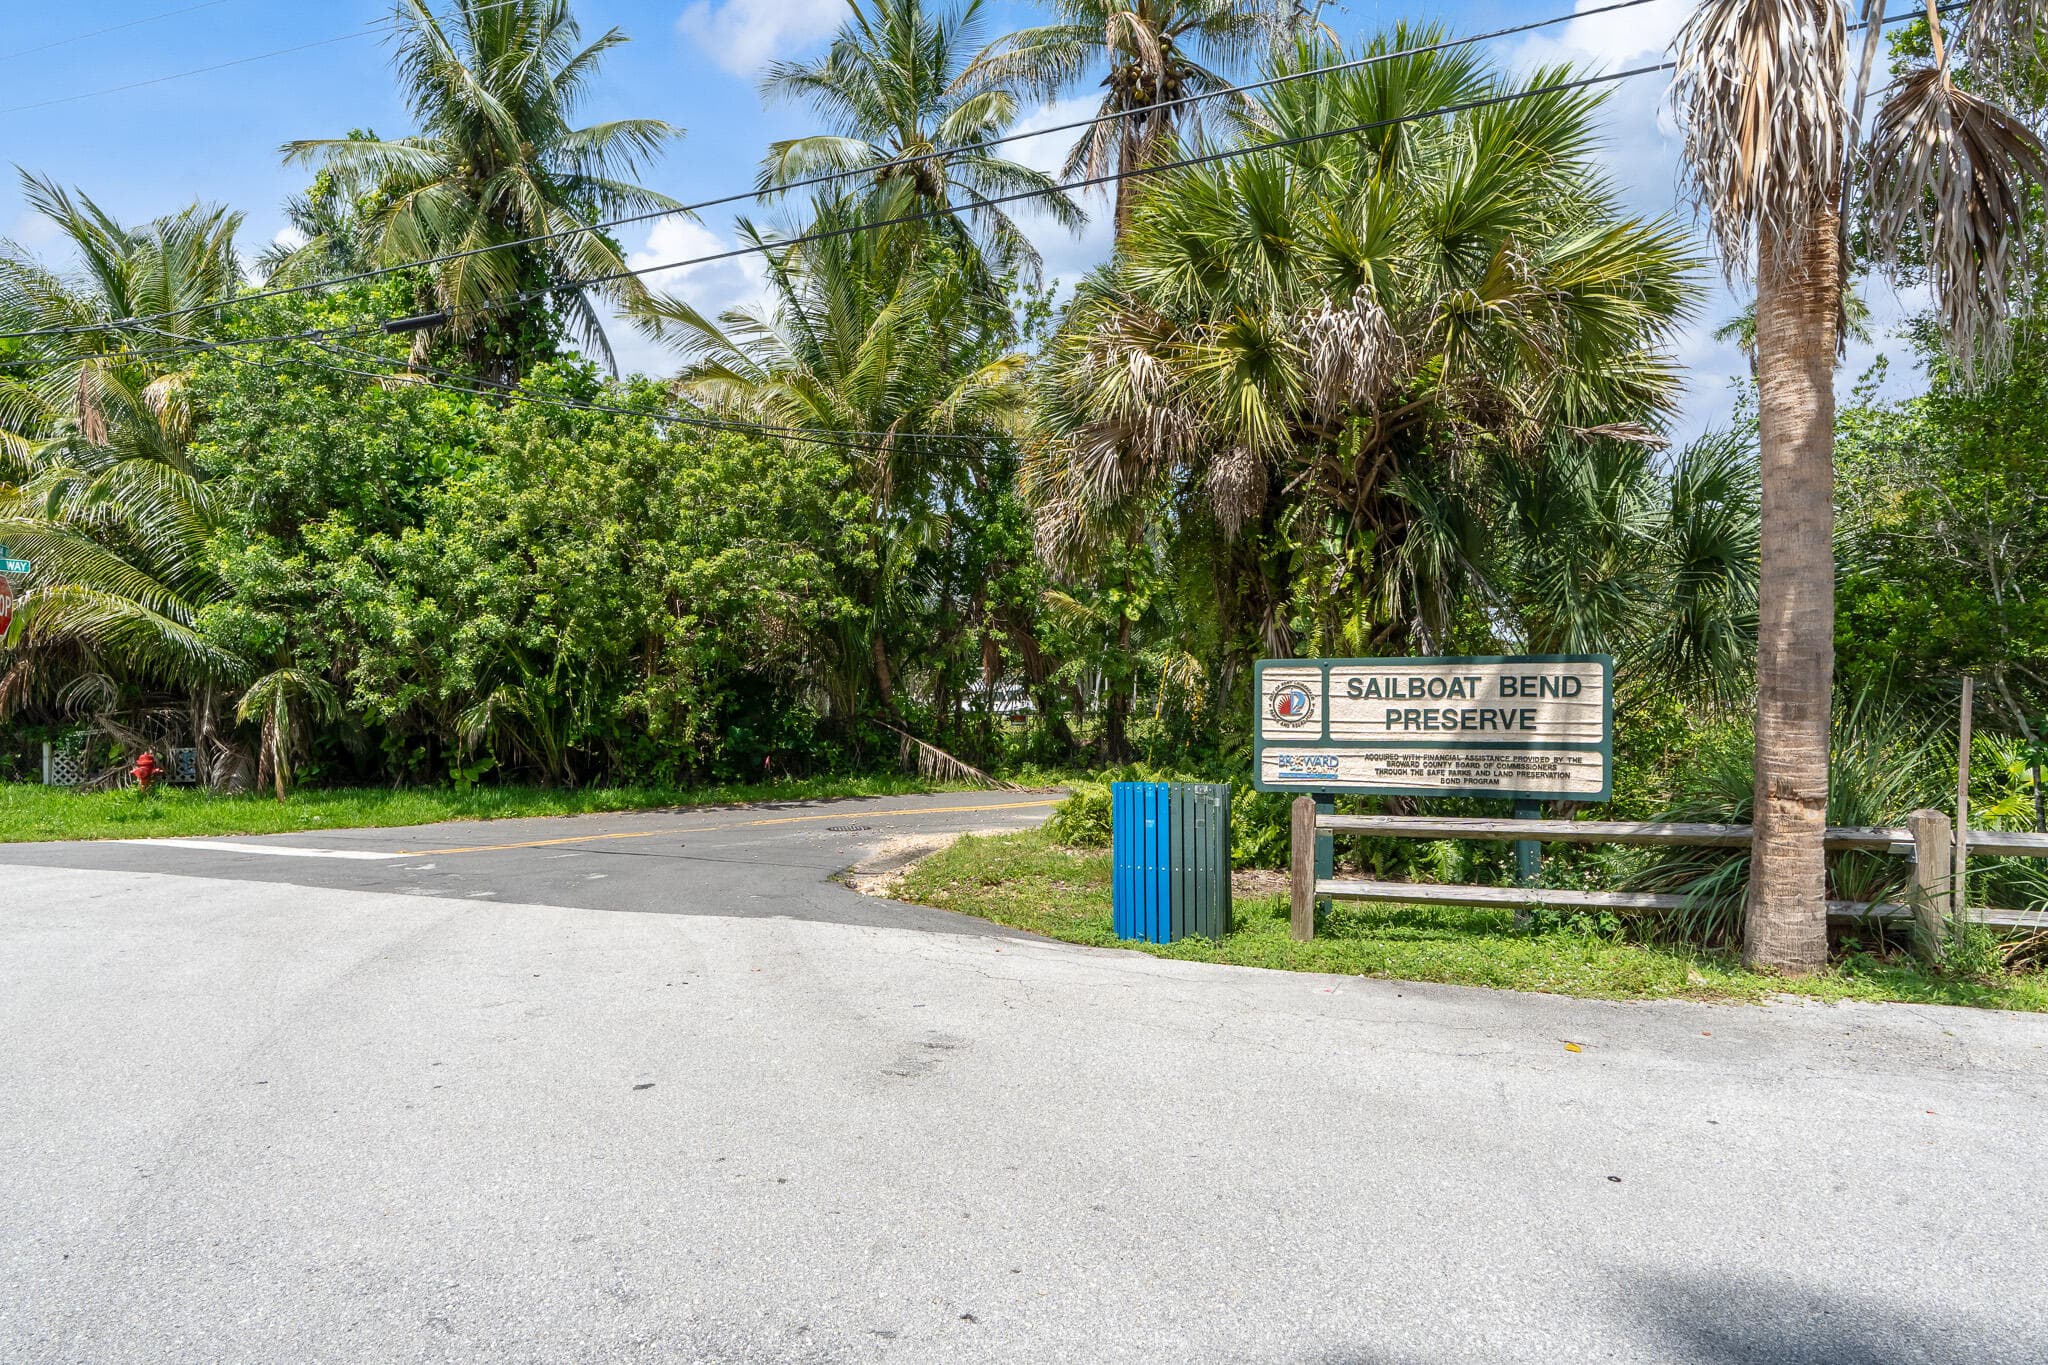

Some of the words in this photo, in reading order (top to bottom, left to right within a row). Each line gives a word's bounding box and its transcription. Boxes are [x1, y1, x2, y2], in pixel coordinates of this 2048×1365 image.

[6, 561, 27, 572] WAY
[1346, 676, 1482, 700] SAILBOAT
[1499, 675, 1582, 698] BEND
[1385, 708, 1537, 731] PRESERVE
[1364, 753, 1399, 761] ACQUIRED
[1386, 761, 1420, 769] BROWARD
[1422, 761, 1452, 769] COUNTY
[1496, 763, 1558, 771] COMMISSIONERS
[1374, 768, 1408, 776] THROUGH
[1427, 769, 1445, 777] SAFE
[1516, 771, 1571, 779] PRESERVATION
